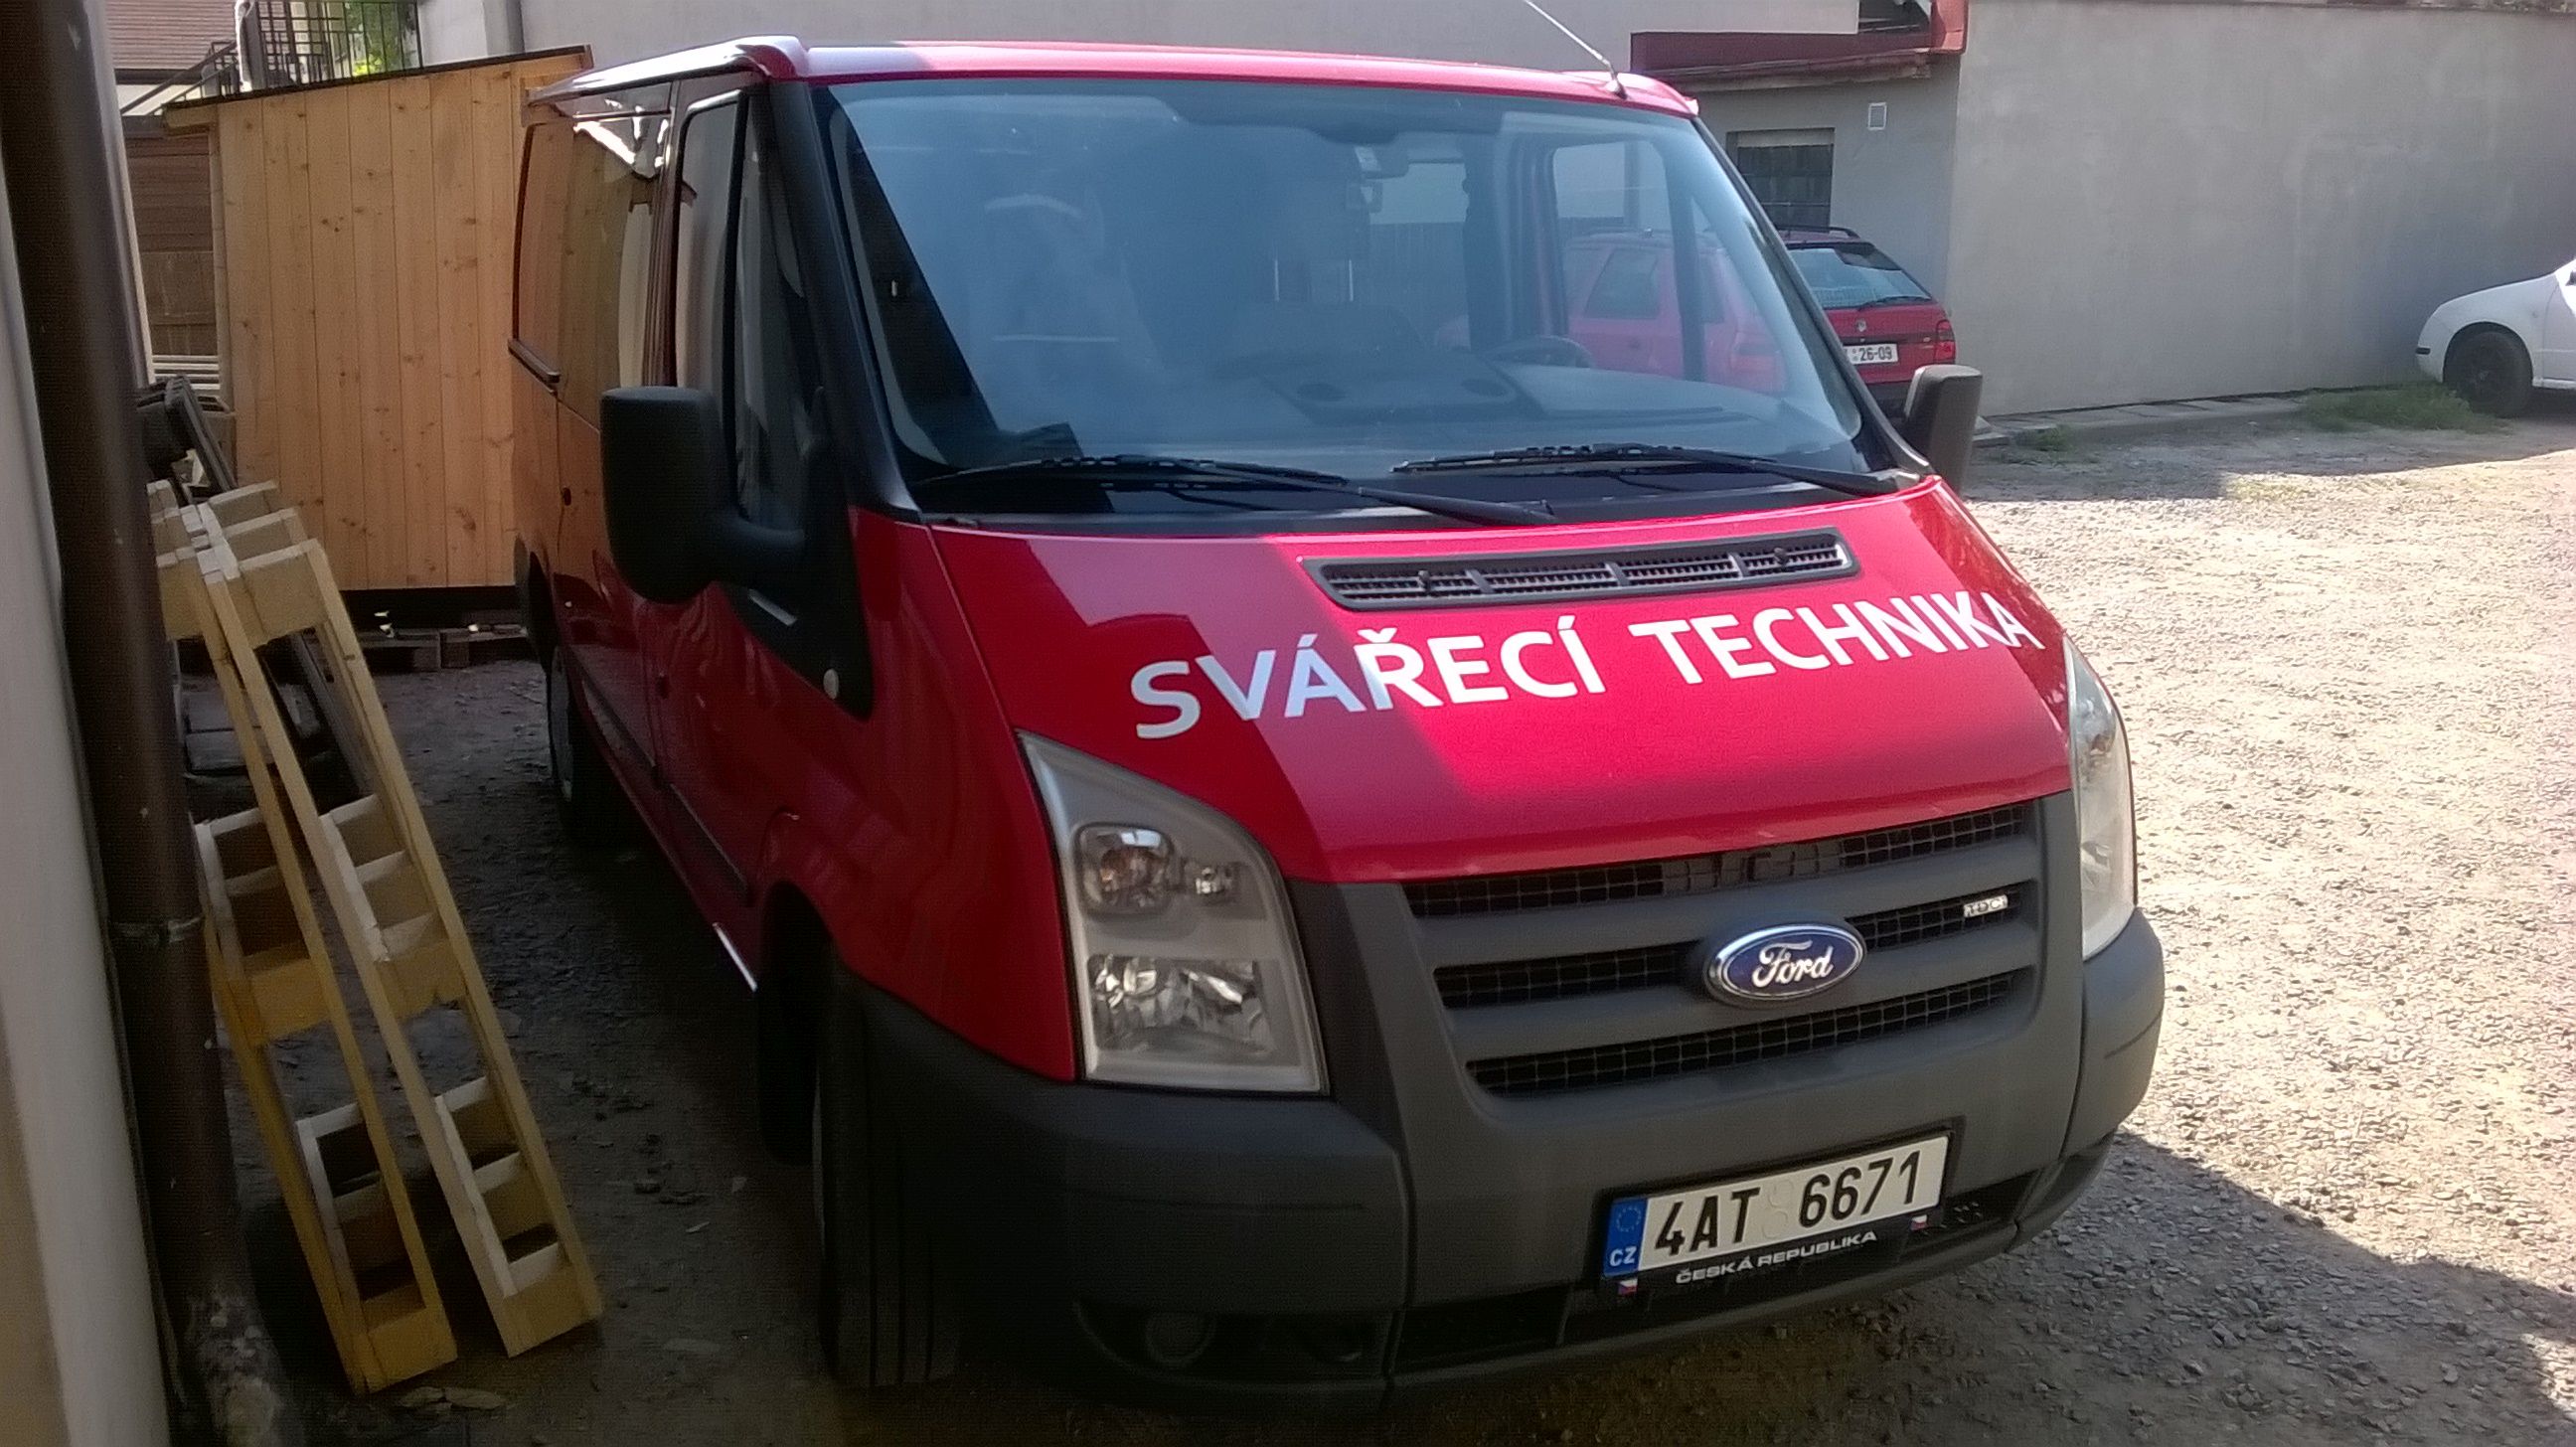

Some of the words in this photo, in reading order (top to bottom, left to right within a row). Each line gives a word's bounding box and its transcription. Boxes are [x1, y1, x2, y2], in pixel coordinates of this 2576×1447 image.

[1858, 346, 1892, 362] 26-09
[1130, 615, 1607, 740] SVÁŘECÍ
[1628, 590, 2045, 686] TECHNIKA
[1751, 939, 1835, 988] Ford
[1655, 1186, 1761, 1257] 4AT
[1799, 1150, 1921, 1228] 6671
[1608, 1245, 1636, 1267] CZ
[1676, 1255, 1756, 1285] ČESKÁ
[1758, 1229, 1877, 1267] REPUBLIKA
